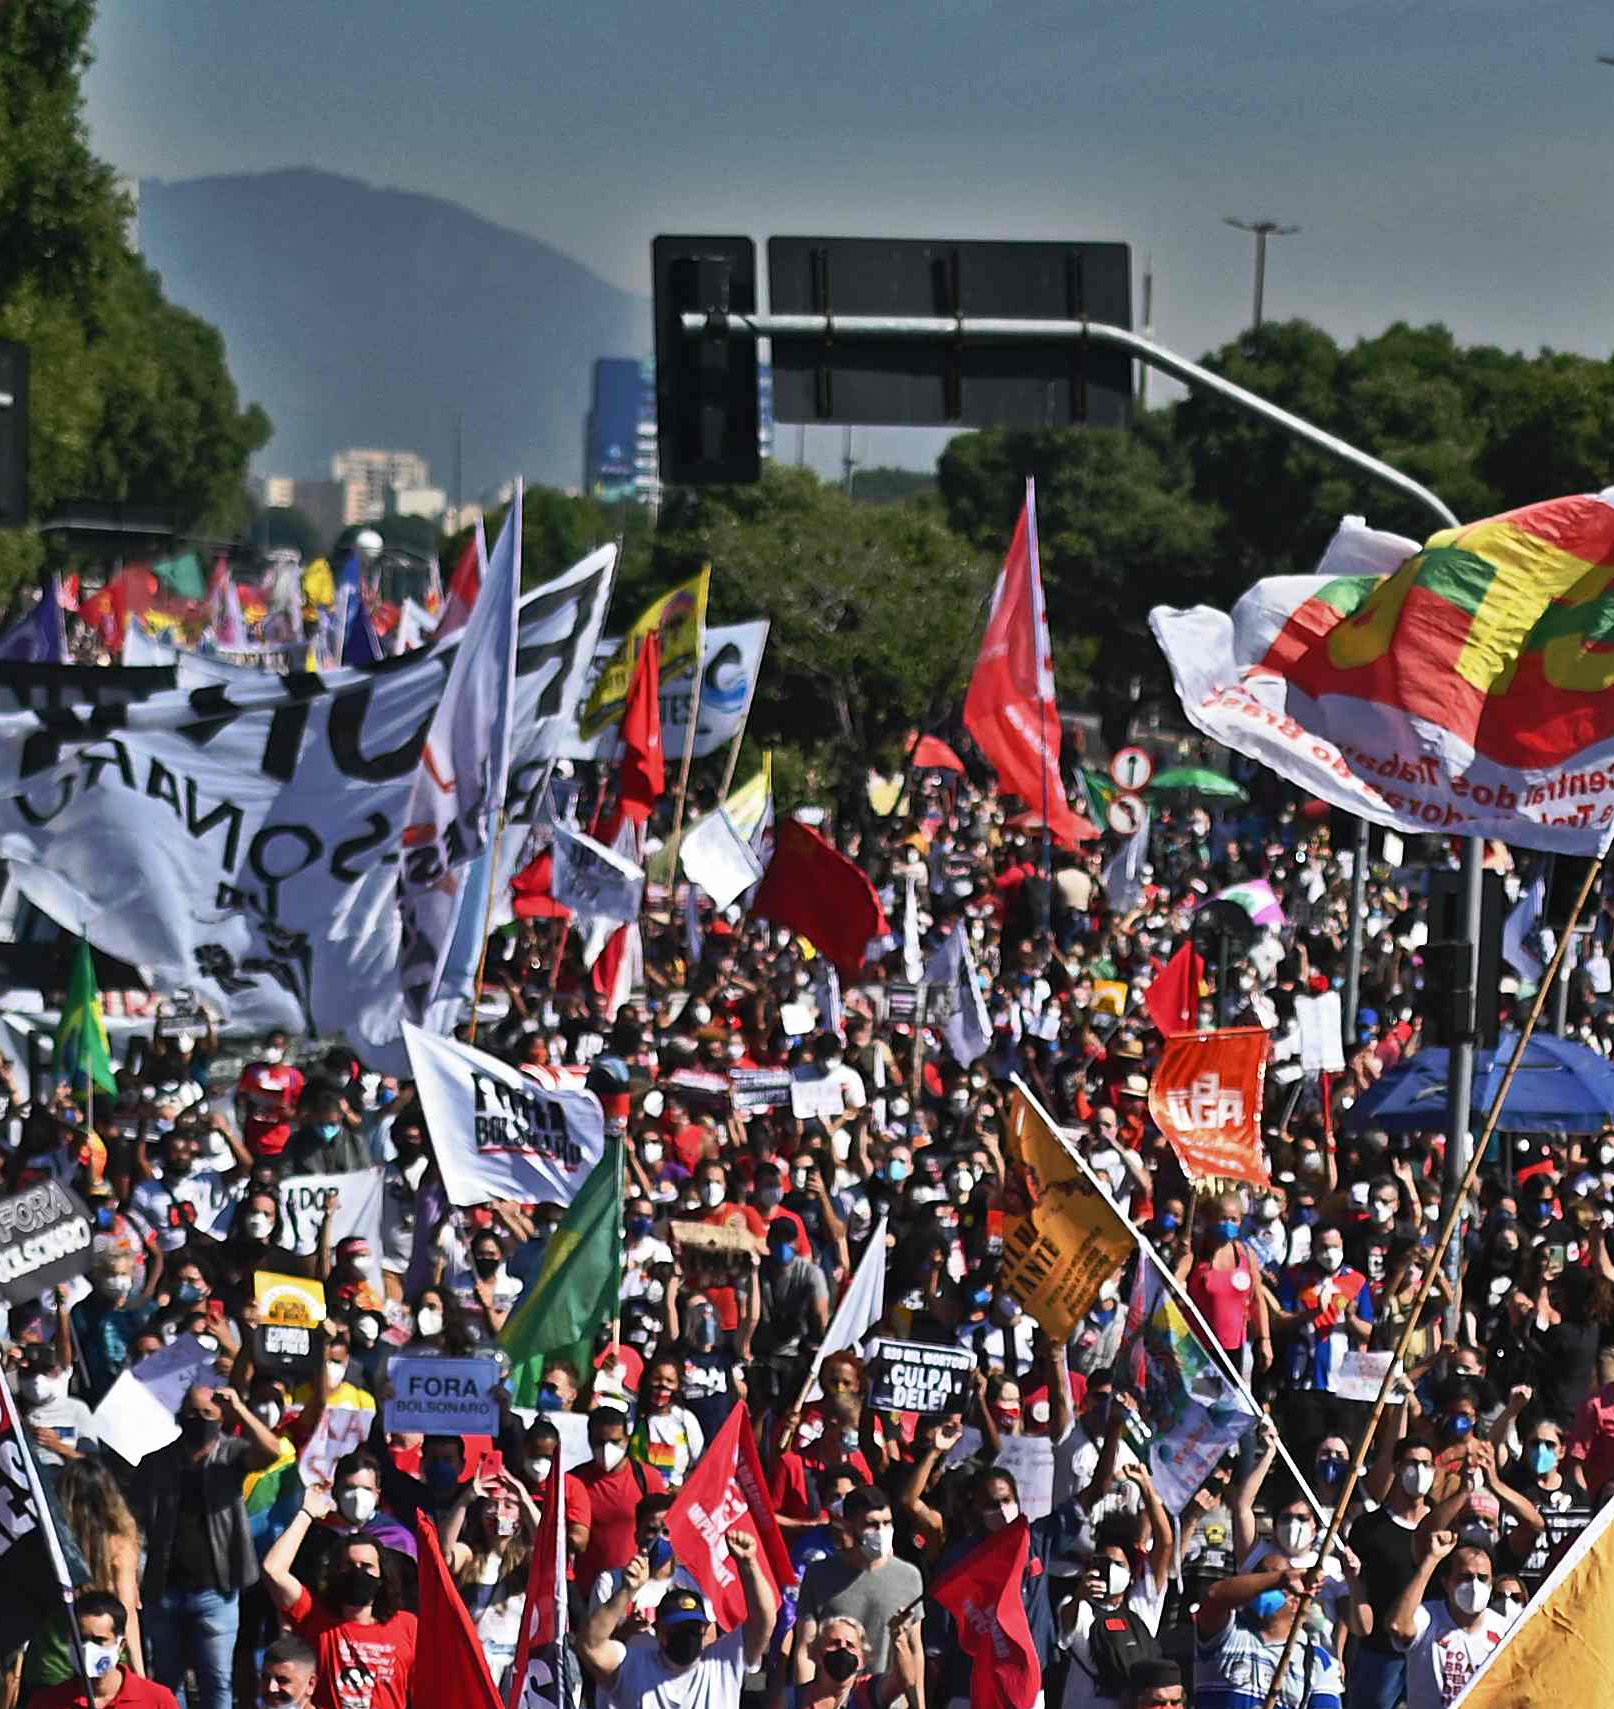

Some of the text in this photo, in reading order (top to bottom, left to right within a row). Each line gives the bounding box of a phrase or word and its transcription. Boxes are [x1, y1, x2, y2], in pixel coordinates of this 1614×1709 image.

[408, 1376, 480, 1398] FORA
[890, 1366, 954, 1393] CULPA
[396, 1400, 490, 1417] BOLSONARO
[892, 1388, 947, 1411] DELE!
